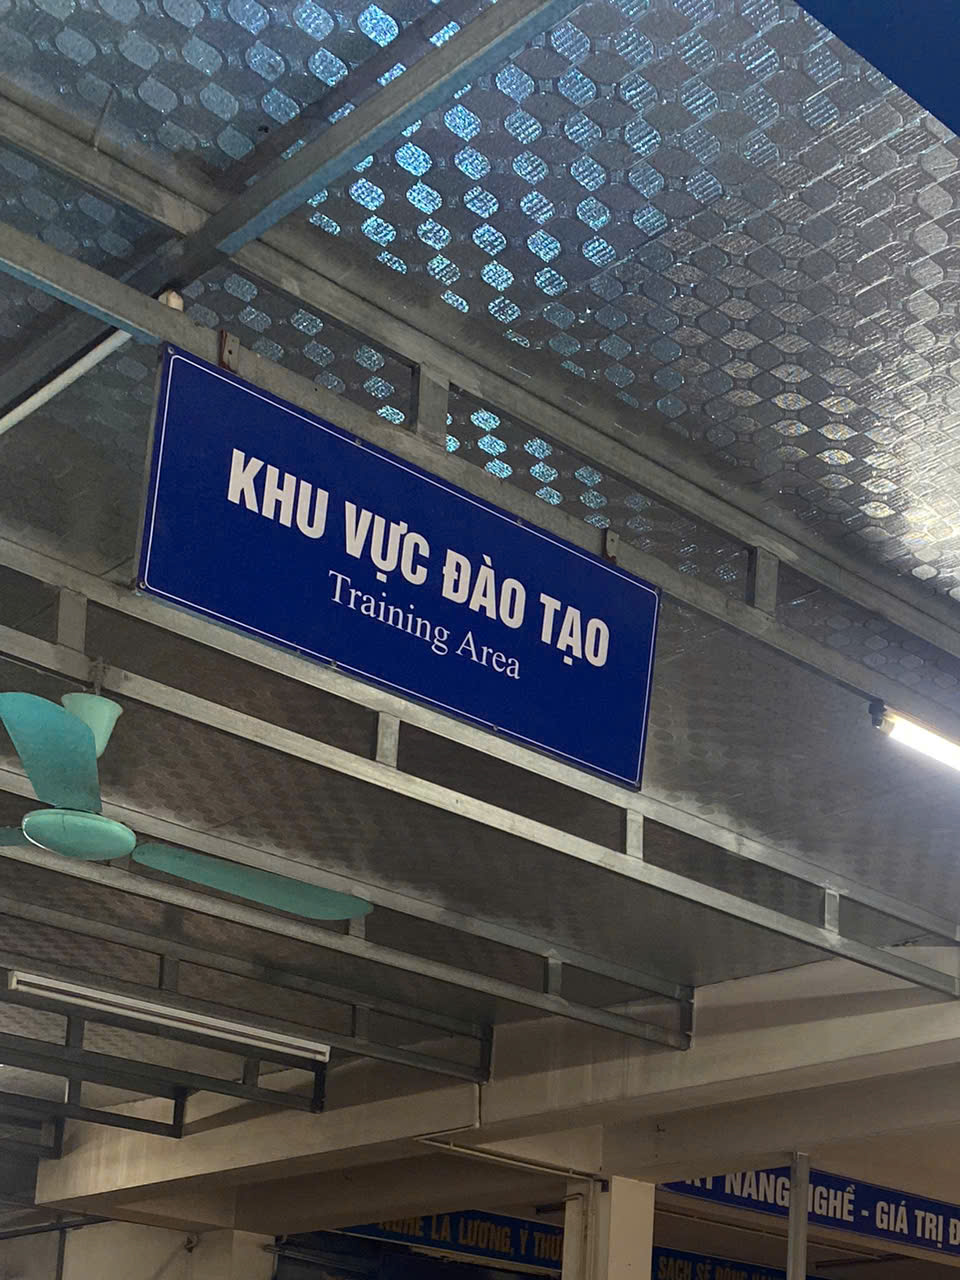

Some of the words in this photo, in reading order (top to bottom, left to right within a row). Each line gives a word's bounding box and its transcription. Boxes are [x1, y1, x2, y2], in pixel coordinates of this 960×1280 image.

[226, 448, 329, 541] KHU
[344, 499, 432, 586] VỰC
[442, 548, 525, 629] ĐÀO
[540, 593, 610, 668] TẠO
[328, 570, 452, 657] Training
[457, 631, 521, 681] Area
[875, 1200, 908, 1235] GIÁ
[914, 1209, 943, 1248] TRỊ
